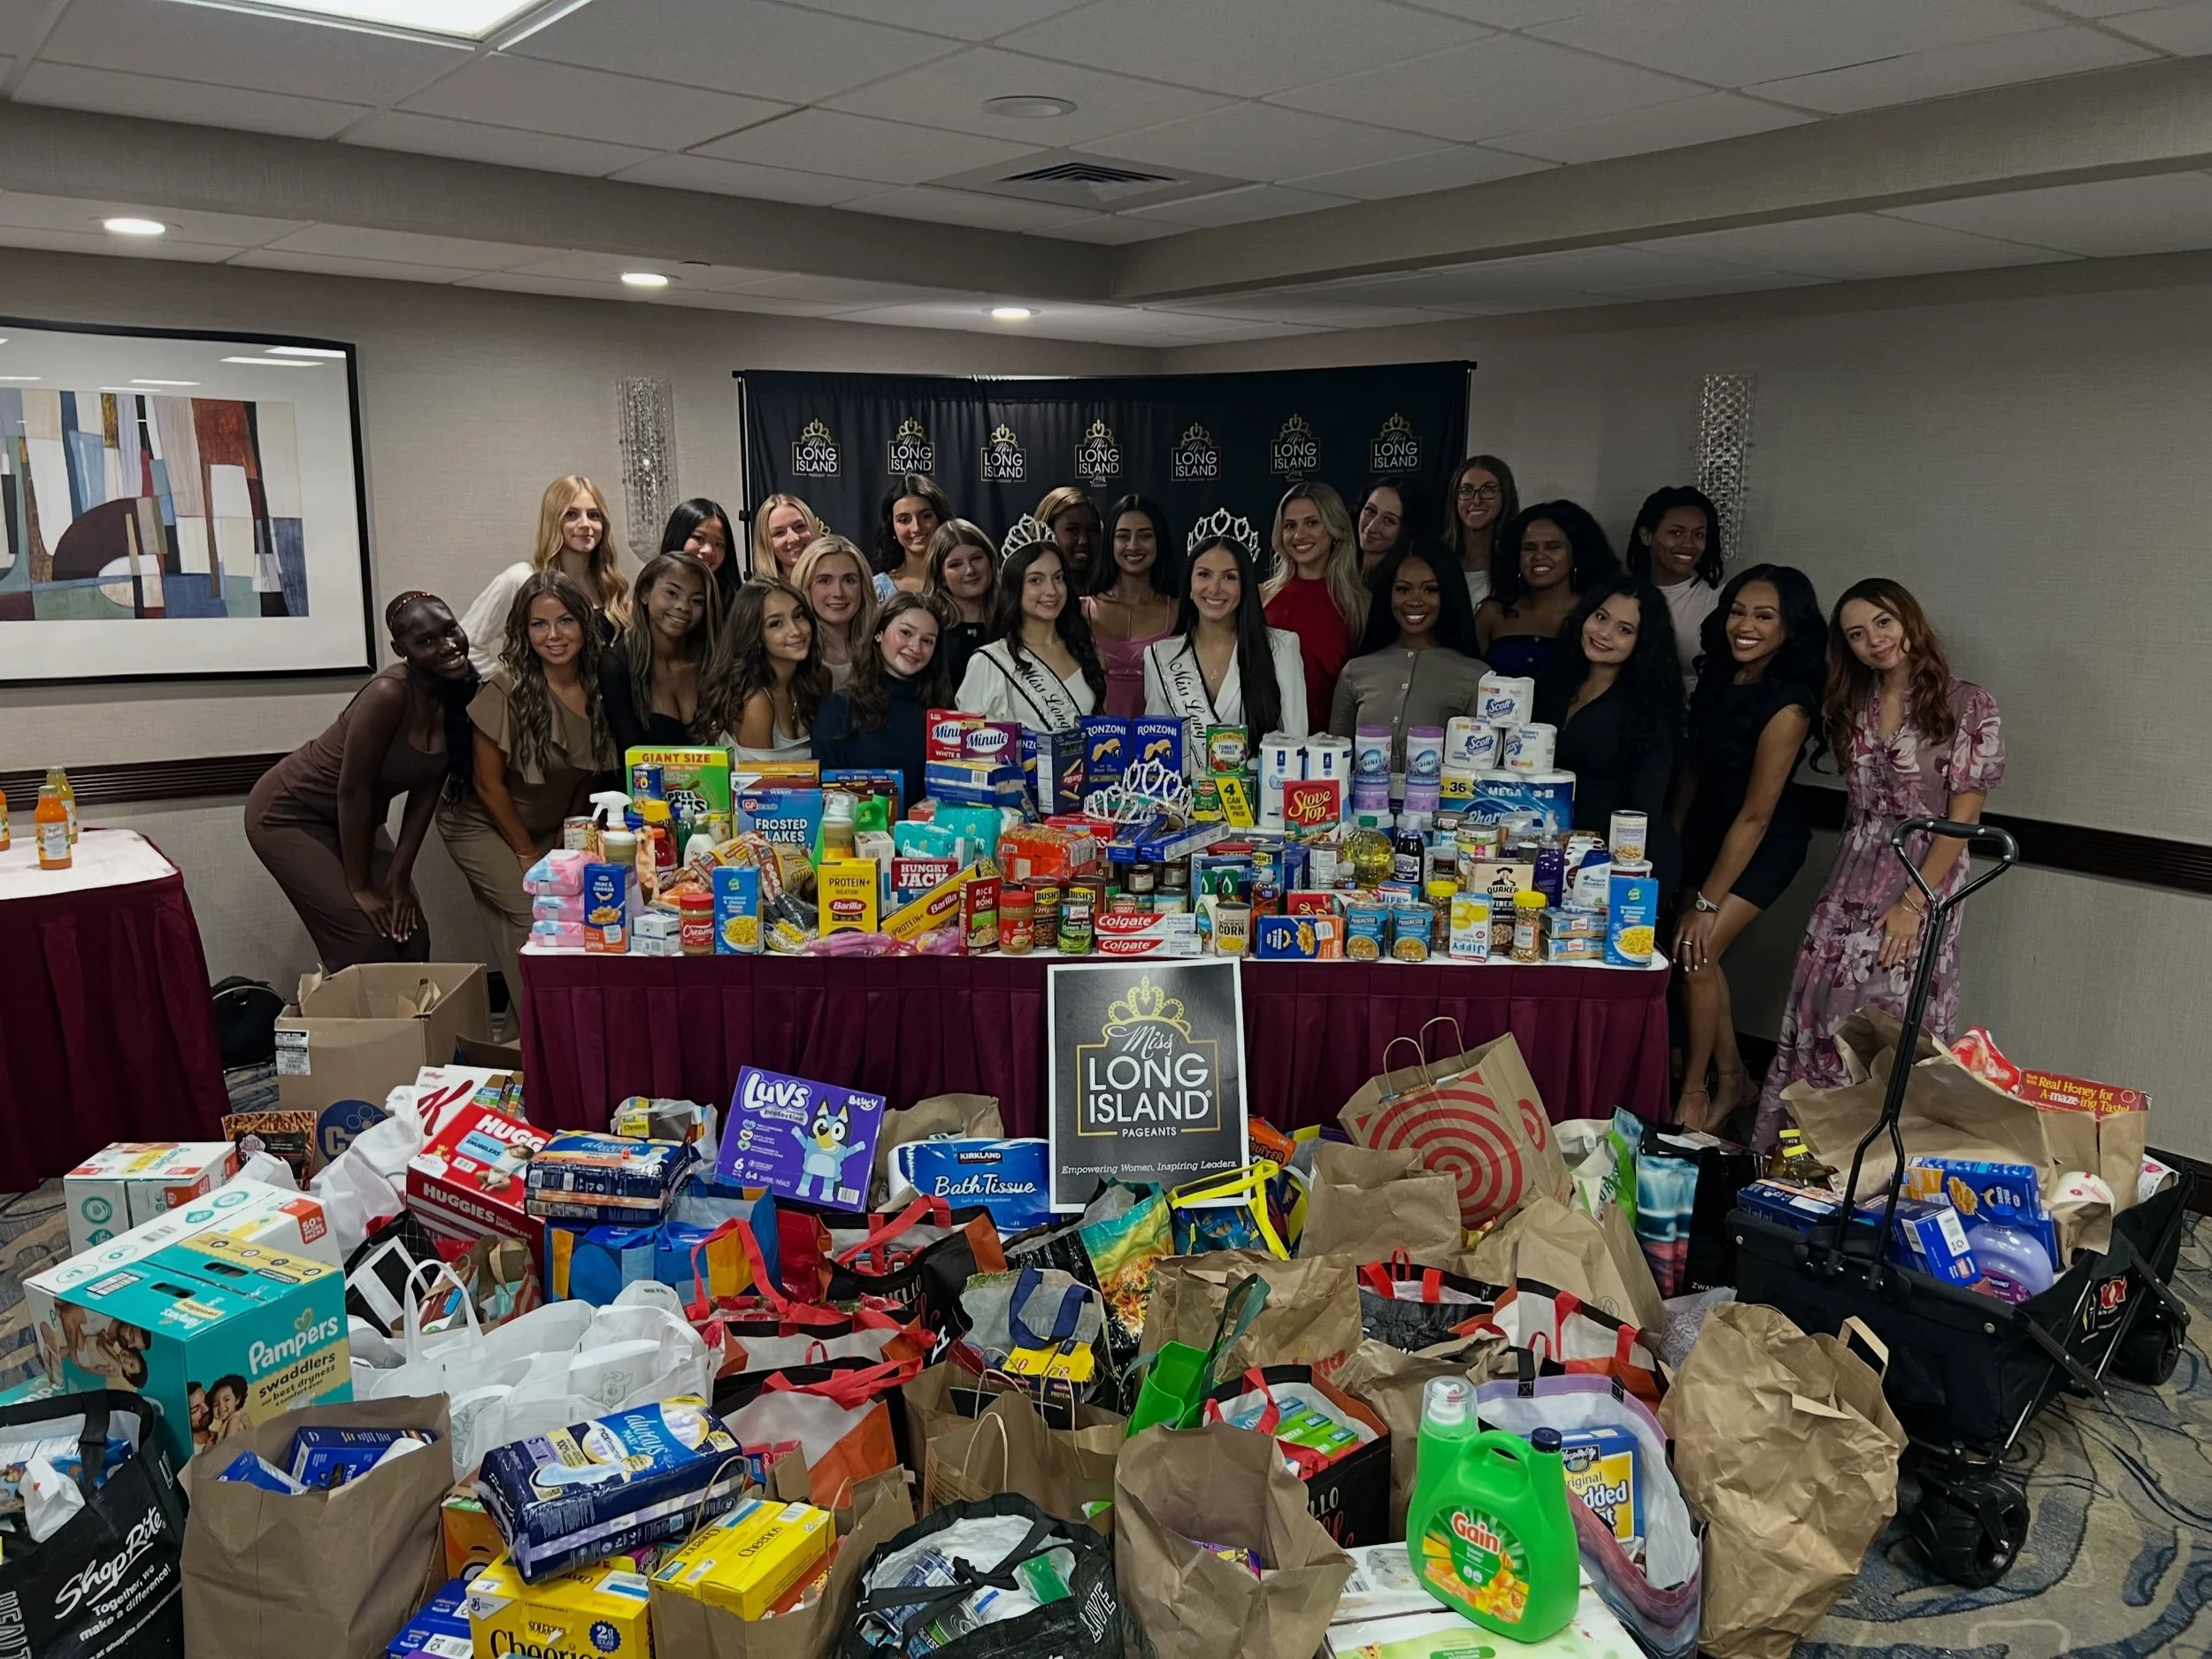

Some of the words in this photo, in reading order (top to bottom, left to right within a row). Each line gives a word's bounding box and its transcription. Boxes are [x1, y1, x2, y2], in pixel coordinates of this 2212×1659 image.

[796, 447, 836, 460] LONG
[891, 446, 932, 459] LONG
[1079, 449, 1119, 462] LONG
[1274, 442, 1317, 457] LONG
[1374, 442, 1417, 457] LONG
[984, 454, 1023, 466] LONG
[1175, 451, 1217, 465] LONG
[1274, 457, 1317, 469] ISLAND
[1374, 456, 1417, 468] ISLAND
[796, 460, 837, 472] ISLAND
[891, 459, 932, 471] ISLAND
[1079, 462, 1119, 474] ISLAND
[1175, 465, 1217, 477] ISLAND
[984, 466, 1023, 478] ISLAND
[1022, 666, 1045, 697] Miss
[1041, 694, 1071, 730] Long
[1169, 662, 1189, 696] Miss
[1185, 698, 1206, 738] Long
[1488, 699, 1510, 711] Scott
[1087, 726, 1126, 736] RONZONI
[1138, 726, 1177, 736] RONZONI
[966, 733, 1009, 749] Minute
[1469, 736, 1491, 749] Scott
[642, 753, 680, 764] GIANT
[684, 753, 710, 764] SIZE
[1224, 783, 1235, 795] 4
[1450, 782, 1466, 792] 36
[1488, 787, 1522, 797] MEGA
[1288, 790, 1332, 817] Stove
[1304, 805, 1326, 823] Top
[756, 818, 808, 831] FROSTED
[901, 864, 949, 874] HUNGRY
[829, 878, 871, 887] PROTEIN+
[898, 874, 949, 887] JACK
[833, 902, 864, 911] Barilla
[930, 895, 958, 914] Barilla
[976, 898, 993, 907] RONI
[892, 914, 924, 937] PROTEIN+
[1098, 916, 1152, 929] Colgate
[683, 923, 715, 936] Creamy
[1218, 926, 1245, 935] CORN
[1102, 941, 1150, 952] Colgate
[1452, 944, 1485, 953] JIFFY
[1107, 1025, 1173, 1060] Miss
[1089, 1053, 1208, 1091] LONG
[2039, 1076, 2061, 1091] Real
[2063, 1081, 2097, 1099] Honey
[2099, 1087, 2114, 1102] for
[2039, 1088, 2098, 1112] A-maze-ing
[418, 1079, 474, 1136] K
[764, 1109, 804, 1122] protection
[475, 1114, 546, 1153] HUGG
[1122, 1127, 1177, 1137] PAGEANTS
[465, 1139, 502, 1156] SNUGGLERS
[581, 1141, 643, 1152] always
[733, 1158, 744, 1170] 6
[1062, 1164, 1118, 1175] Empowering
[1121, 1164, 1155, 1172] Women,
[1157, 1162, 1198, 1173] Inspiring
[1201, 1160, 1237, 1170] Leaders.
[745, 1171, 757, 1180] 64
[934, 1175, 984, 1196] Bath
[982, 1173, 1036, 1194] Tissue
[423, 1182, 495, 1224] HUGGIES
[302, 1217, 323, 1231] 50%
[249, 1317, 338, 1375] Pampers
[259, 1352, 335, 1398] swaddlers
[273, 1385, 295, 1401] best
[297, 1364, 335, 1387] dryness
[622, 1430, 637, 1446] MAXI
[625, 1414, 667, 1455] always
[1567, 1471, 1602, 1489] riginal
[1451, 1511, 1500, 1555] Gain
[738, 1526, 782, 1557] Cheerios
[54, 1506, 163, 1620] ShopRite
[92, 1578, 143, 1617] Together,
[142, 1564, 155, 1581] we
[79, 1616, 114, 1642] make
[116, 1610, 124, 1619] a
[126, 1563, 172, 1612] difference!
[1079, 1581, 1118, 1644] LIVE
[597, 1622, 613, 1635] 2g
